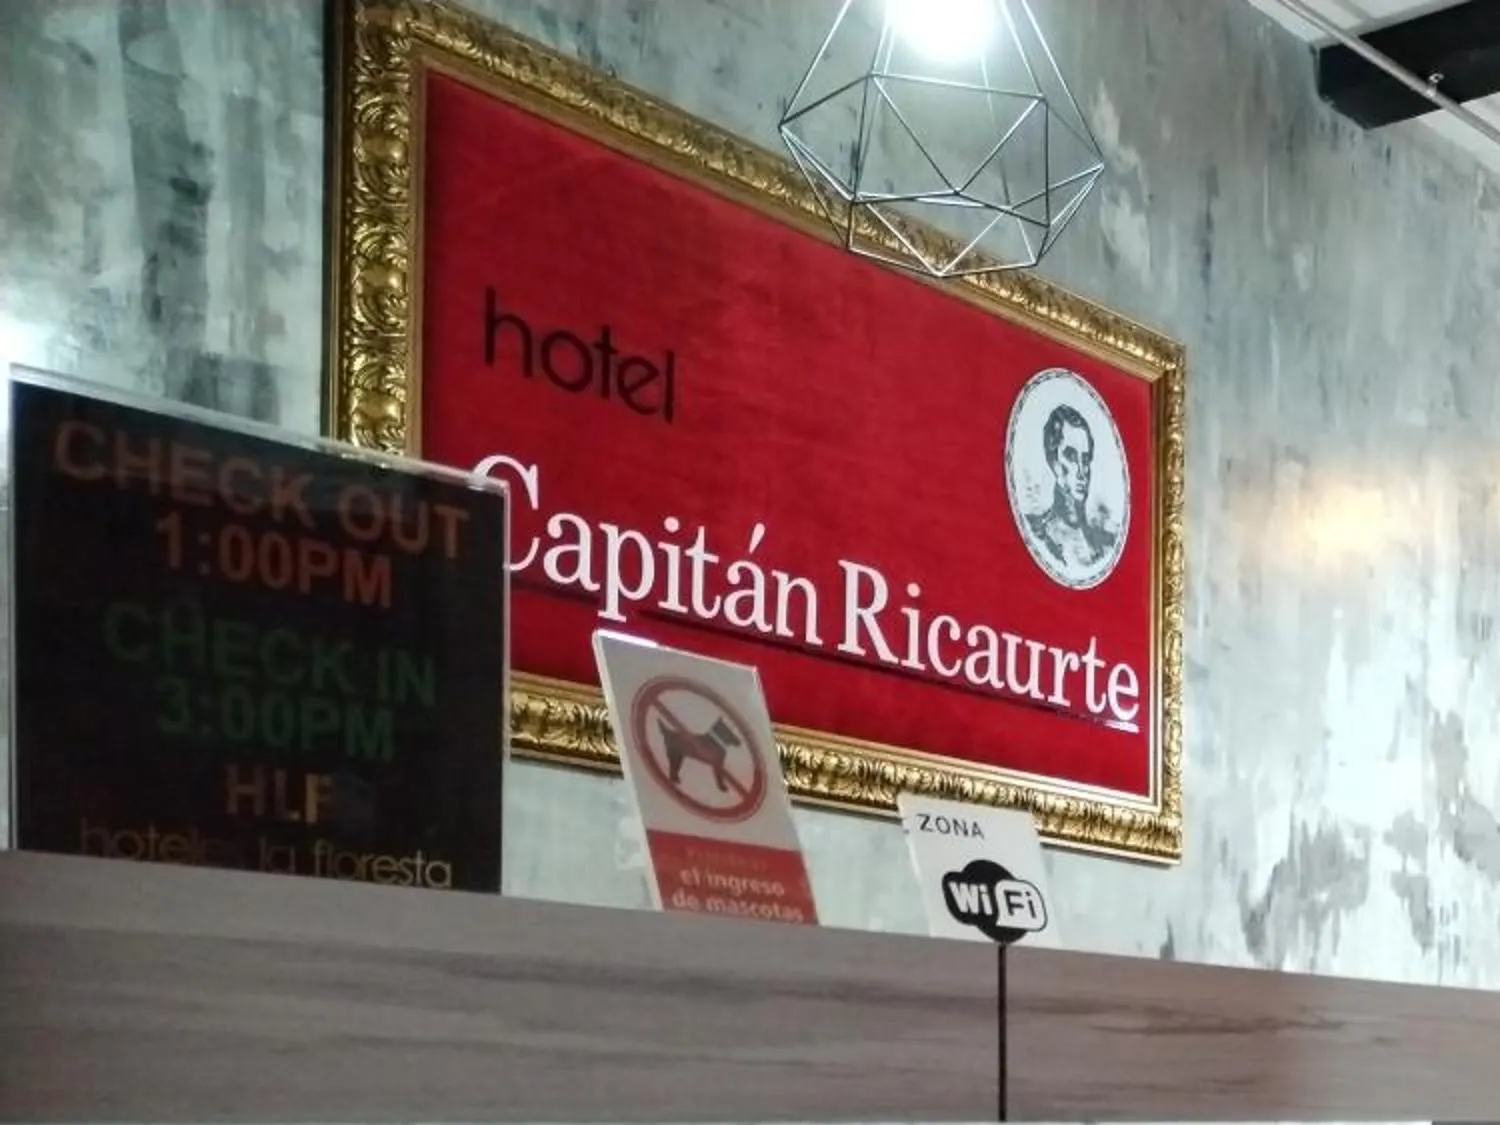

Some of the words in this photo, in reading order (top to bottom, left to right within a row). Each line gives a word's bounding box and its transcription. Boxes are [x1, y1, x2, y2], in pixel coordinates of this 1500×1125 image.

[483, 286, 676, 424] hotel
[53, 418, 316, 529] CHECK
[338, 482, 470, 560] OUT
[156, 510, 394, 609] 1:00PM
[471, 455, 823, 647] Capitán
[838, 558, 1141, 722] Ricaurte
[103, 599, 354, 695] CHECK
[378, 646, 437, 708] IN
[157, 676, 397, 765] 3:00PM
[313, 837, 453, 888] floresta
[916, 813, 985, 839] ZONA
[679, 865, 701, 887] el
[704, 868, 786, 899] ingreso
